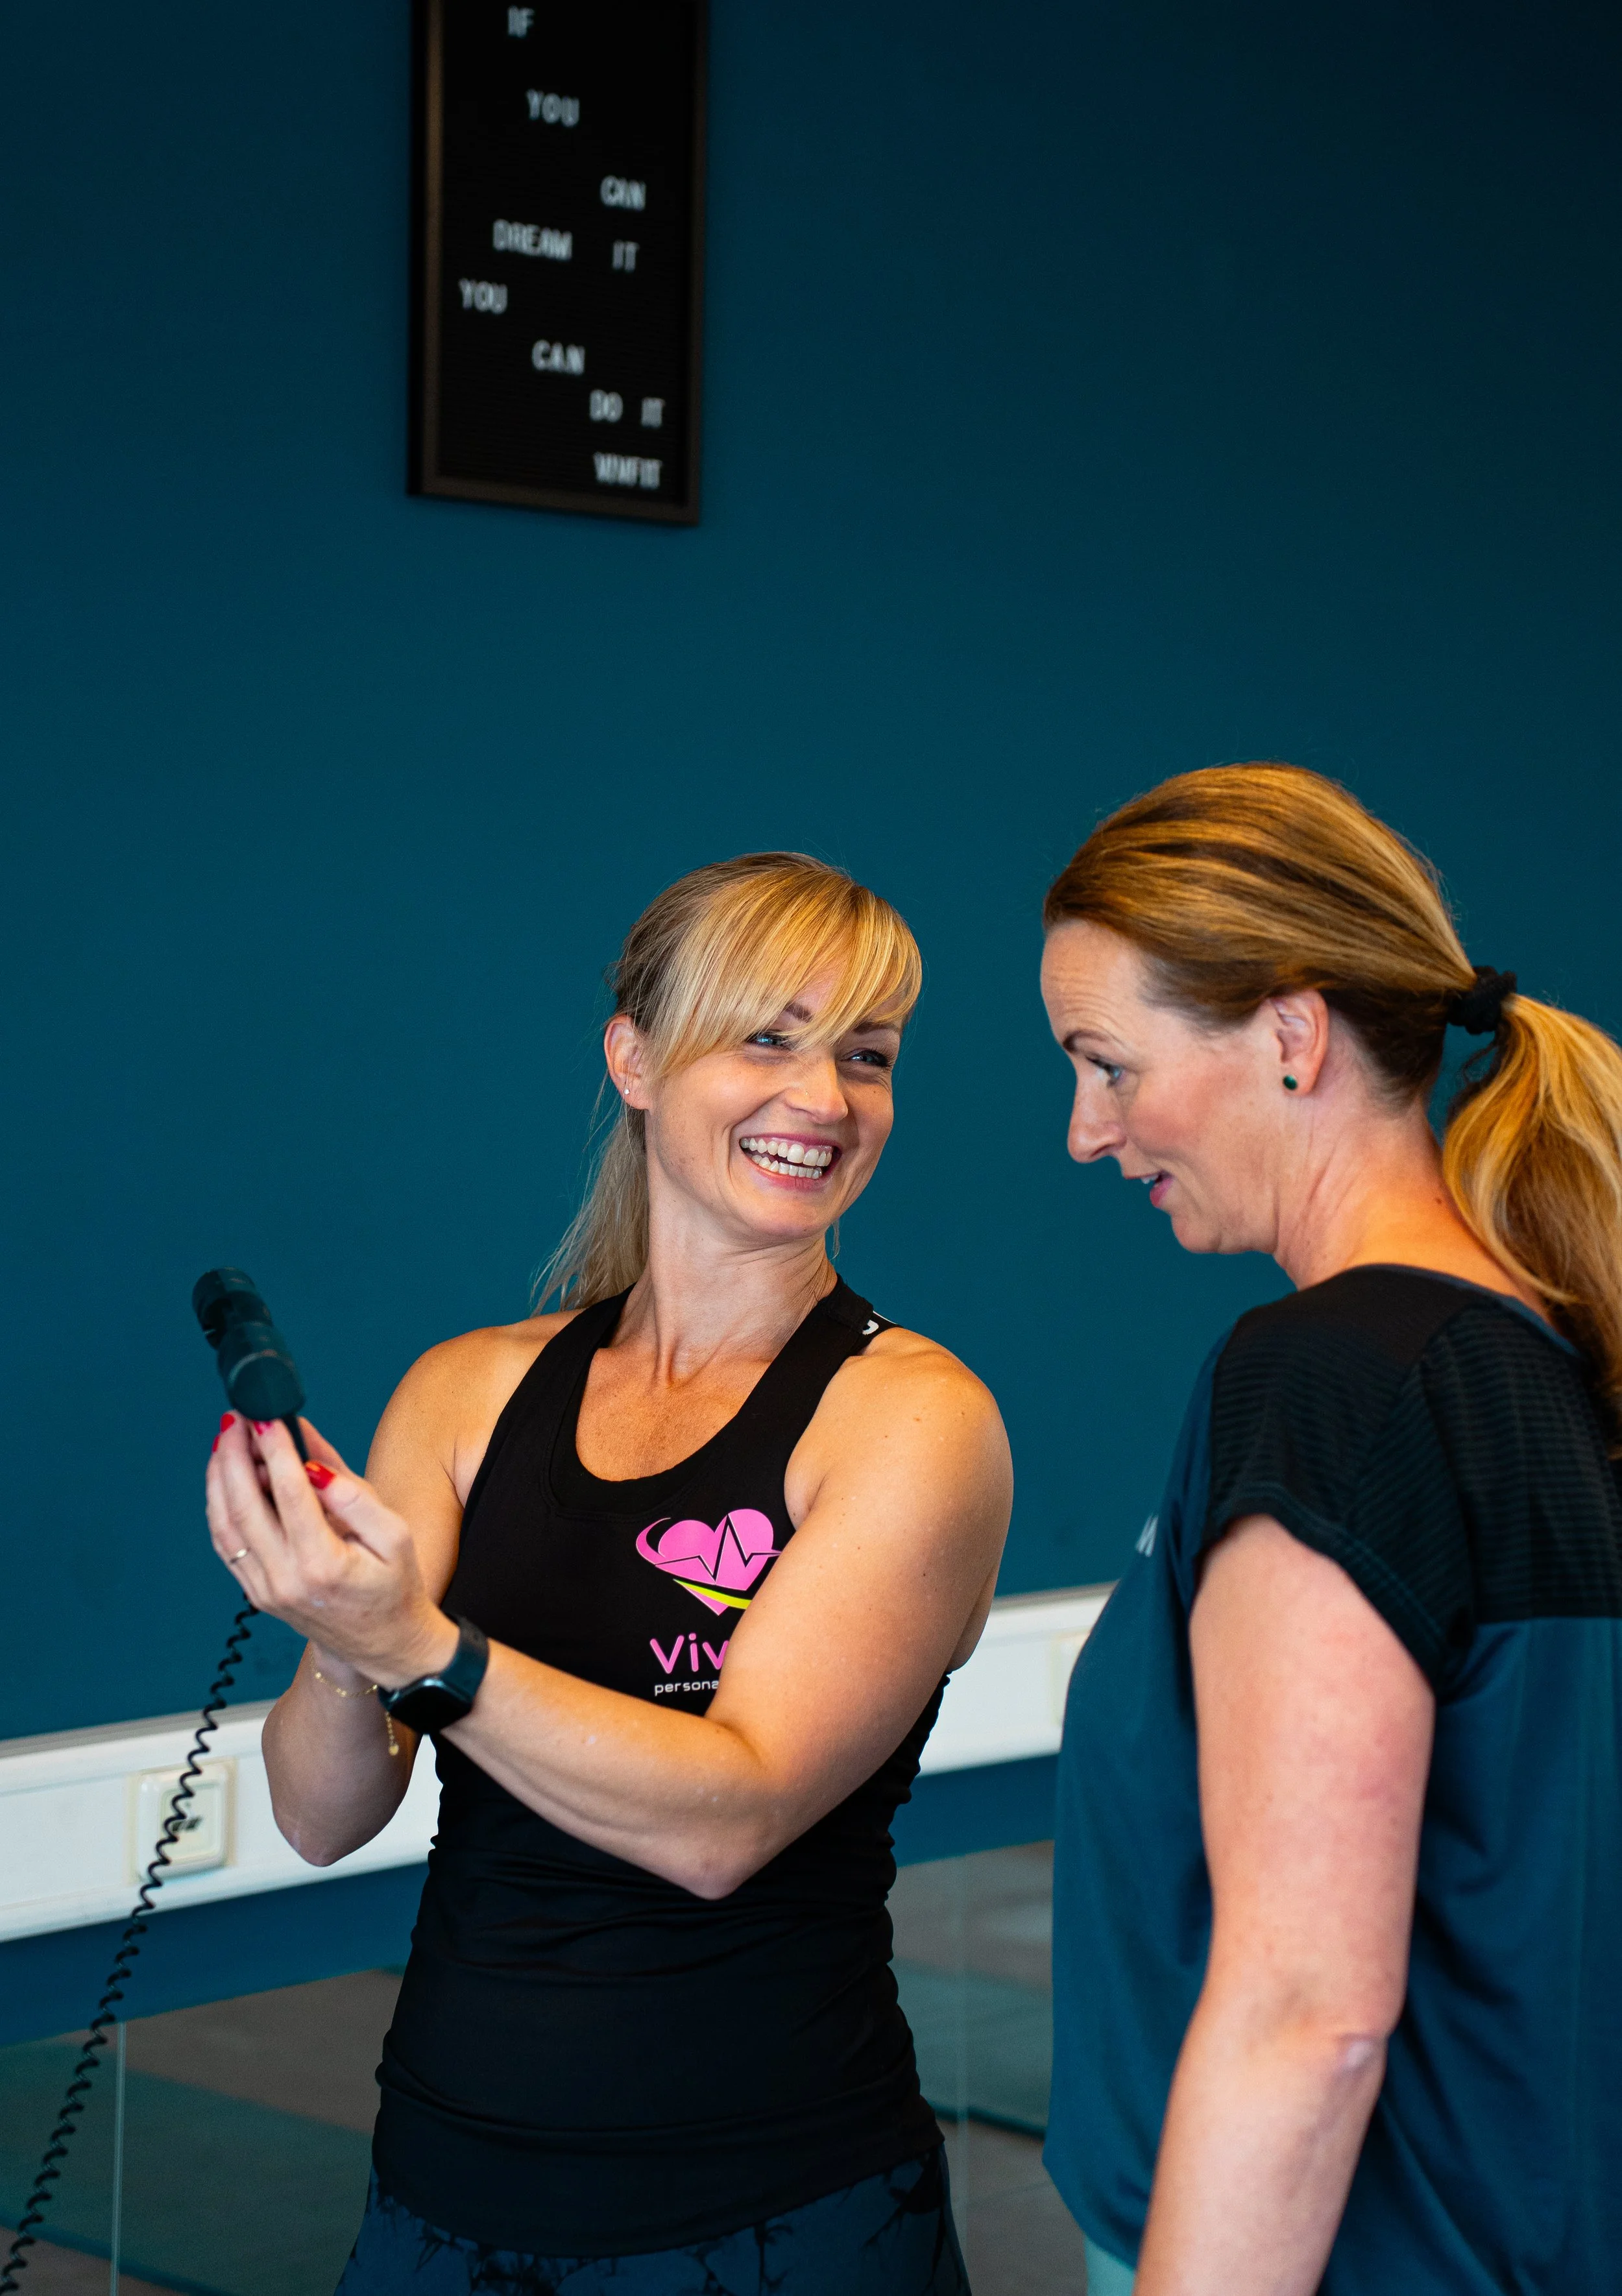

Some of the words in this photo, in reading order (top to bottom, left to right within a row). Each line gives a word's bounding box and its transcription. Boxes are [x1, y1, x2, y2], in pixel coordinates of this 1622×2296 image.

[508, 6, 534, 36] IF
[527, 90, 580, 127] YOU
[601, 175, 646, 210] CAN
[493, 219, 572, 260] DREAM
[612, 241, 638, 271] IT
[459, 279, 508, 313] YOU
[531, 339, 585, 374] CAN
[590, 389, 623, 422] DO
